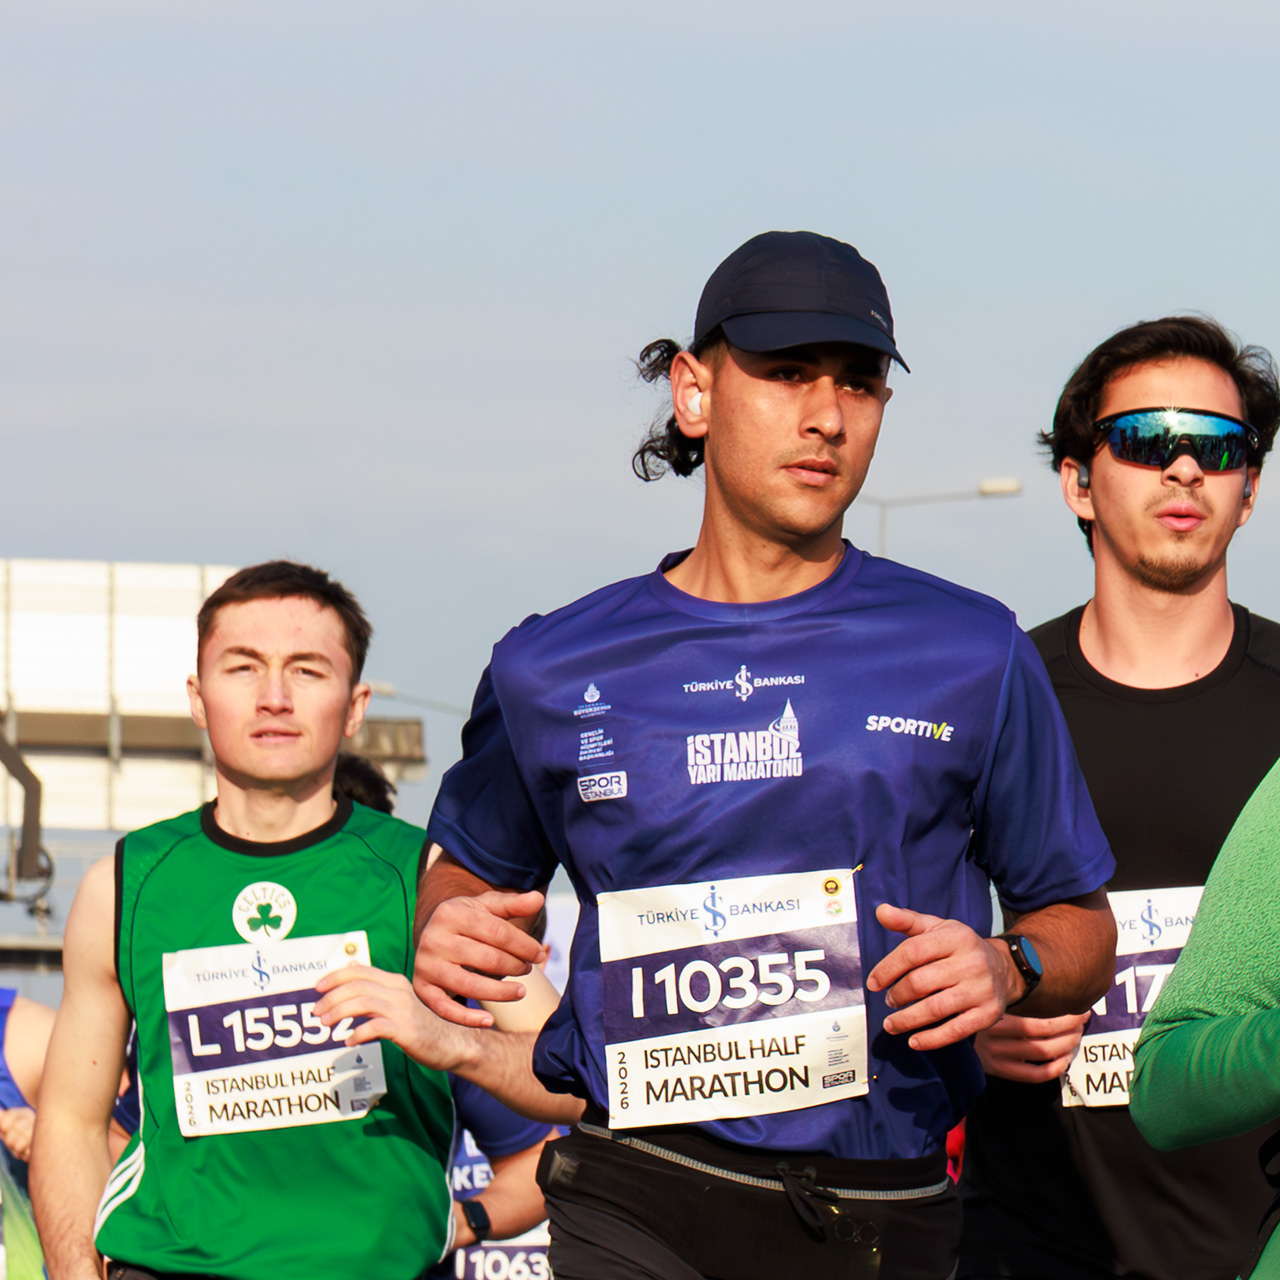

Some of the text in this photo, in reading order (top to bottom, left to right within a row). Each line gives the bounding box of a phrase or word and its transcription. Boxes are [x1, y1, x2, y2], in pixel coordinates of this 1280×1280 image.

[683, 679, 734, 693] TÜRKİYE
[753, 675, 805, 687] BANKASI
[865, 715, 954, 742] SPORTIVE
[687, 731, 802, 766] İSTANBUL
[579, 776, 622, 791] SPOR
[687, 758, 803, 785] YARI MARATONU
[239, 886, 291, 913] CELTICS
[637, 907, 700, 926] TÜRKİYE
[729, 899, 800, 916] BANKASI
[654, 949, 831, 1015] 10355
[188, 1014, 221, 1057] L
[644, 1040, 745, 1069] ISTANBUL
[749, 1035, 806, 1059] HALF
[206, 1069, 290, 1095] ISTANBUL
[292, 1066, 336, 1086] HALF
[645, 1066, 810, 1105] MARATHON
[208, 1090, 341, 1124] MARATHON
[453, 1163, 494, 1191] KE
